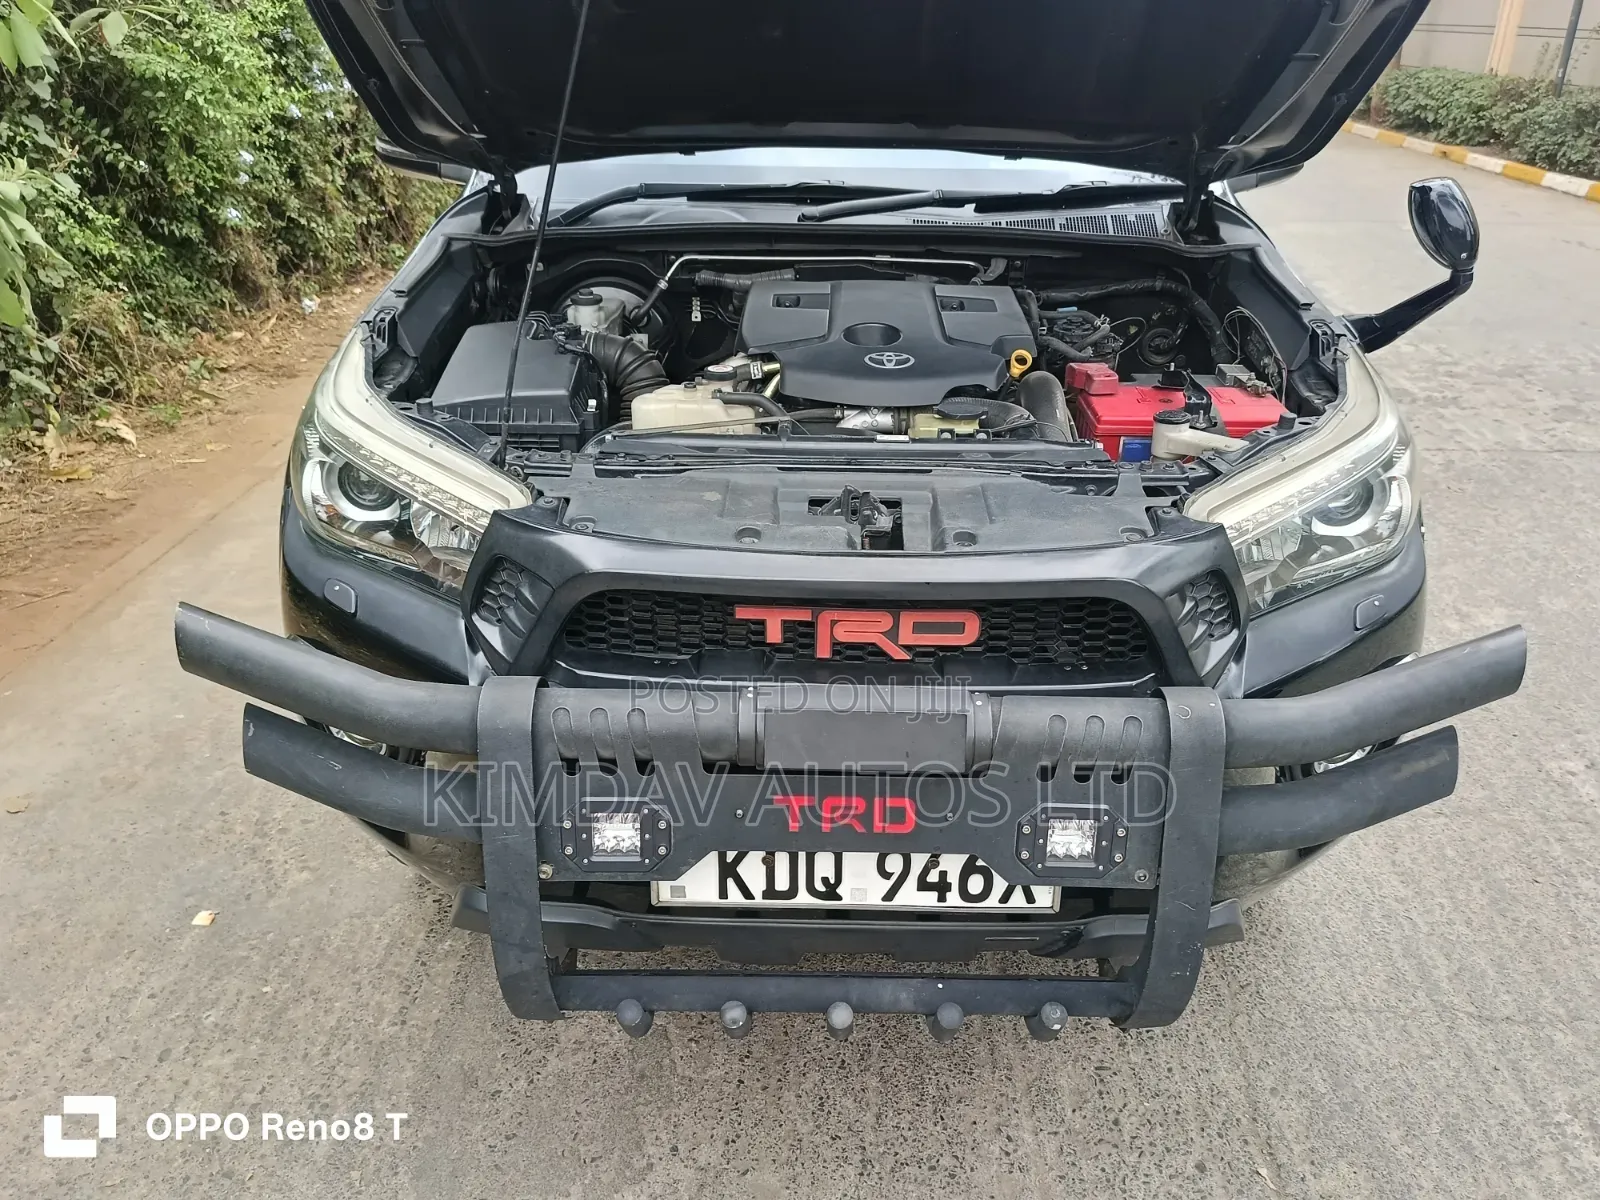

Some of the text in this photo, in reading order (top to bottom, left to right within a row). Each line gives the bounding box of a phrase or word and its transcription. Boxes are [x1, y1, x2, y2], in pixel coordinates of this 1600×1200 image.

[735, 606, 981, 660] TRD
[773, 794, 916, 835] TRD
[718, 850, 843, 902] KDQ
